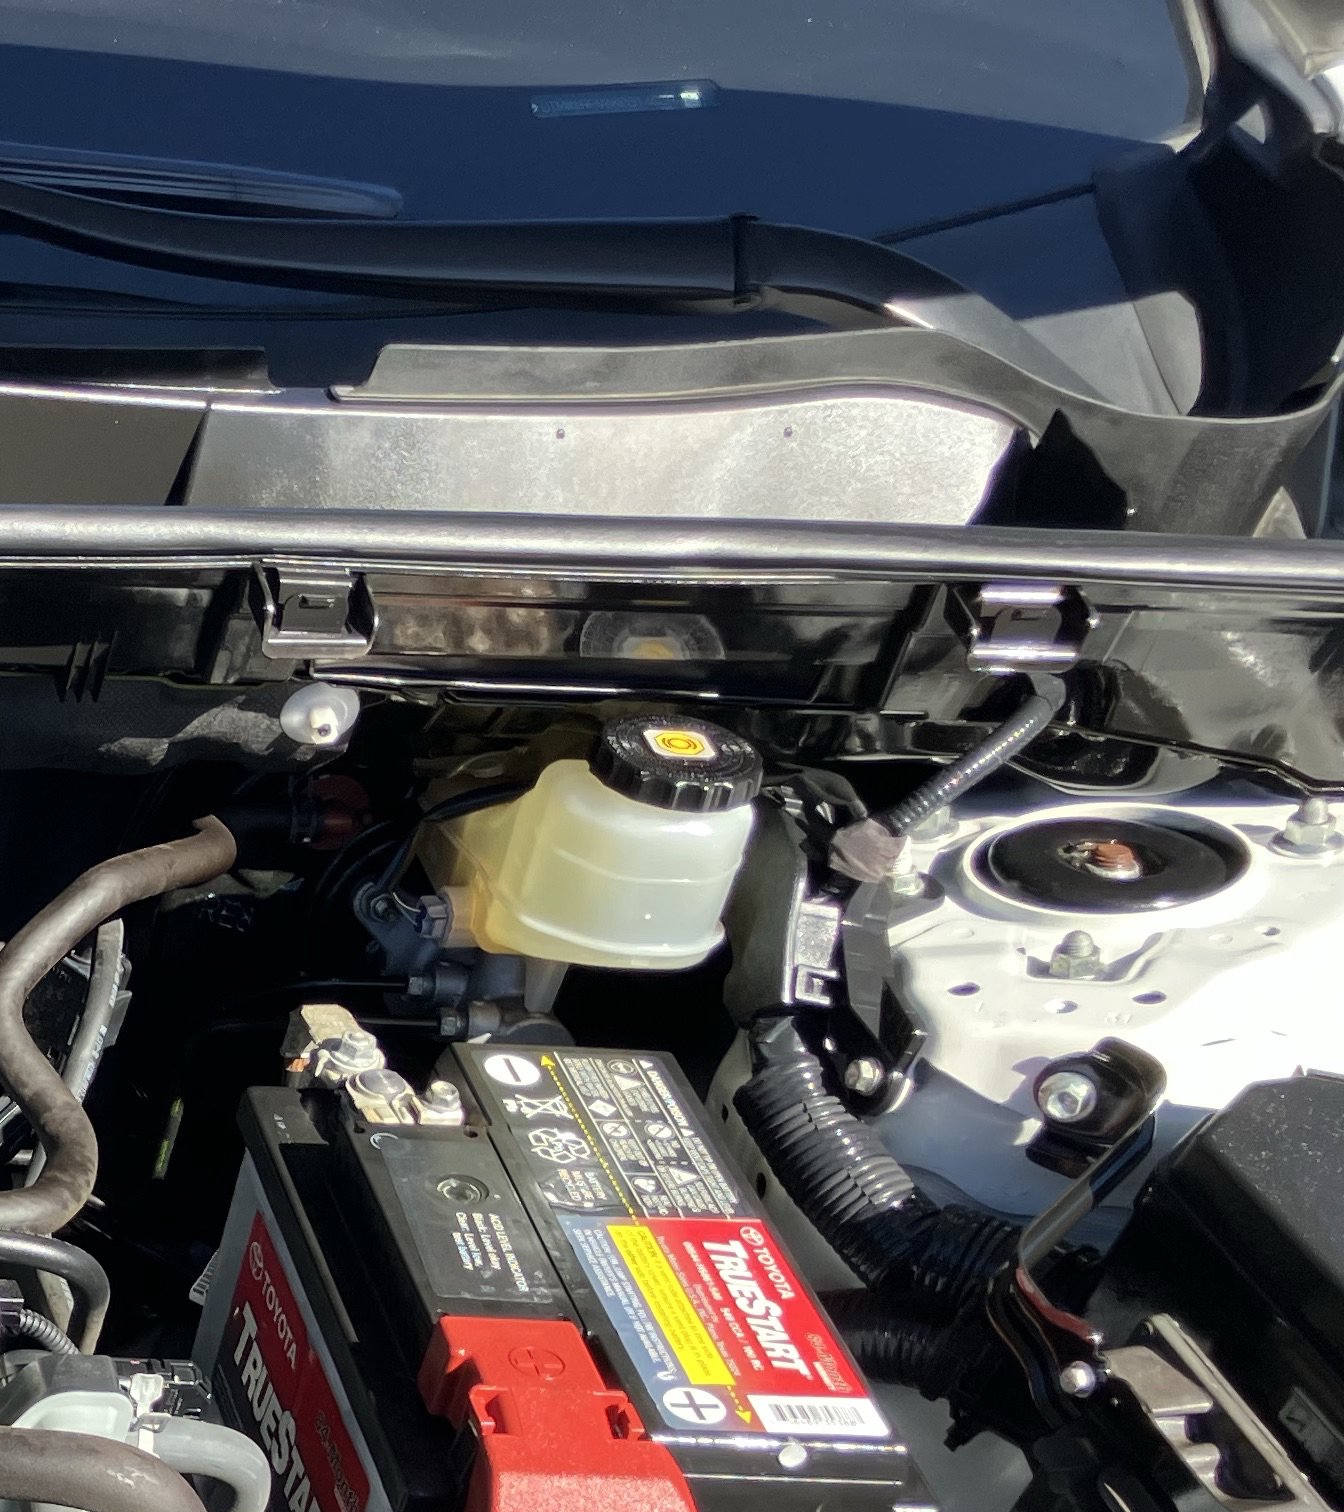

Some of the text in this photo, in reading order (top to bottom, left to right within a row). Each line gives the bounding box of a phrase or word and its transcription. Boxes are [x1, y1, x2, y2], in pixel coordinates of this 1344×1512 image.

[555, 1168, 583, 1200] RECYCLED
[569, 1170, 595, 1200] MUST BE
[582, 1171, 608, 1200] BATTERY
[494, 1230, 514, 1253] LEVEL
[750, 1247, 797, 1299] TOYOTA
[262, 1271, 297, 1370] TOYOTA
